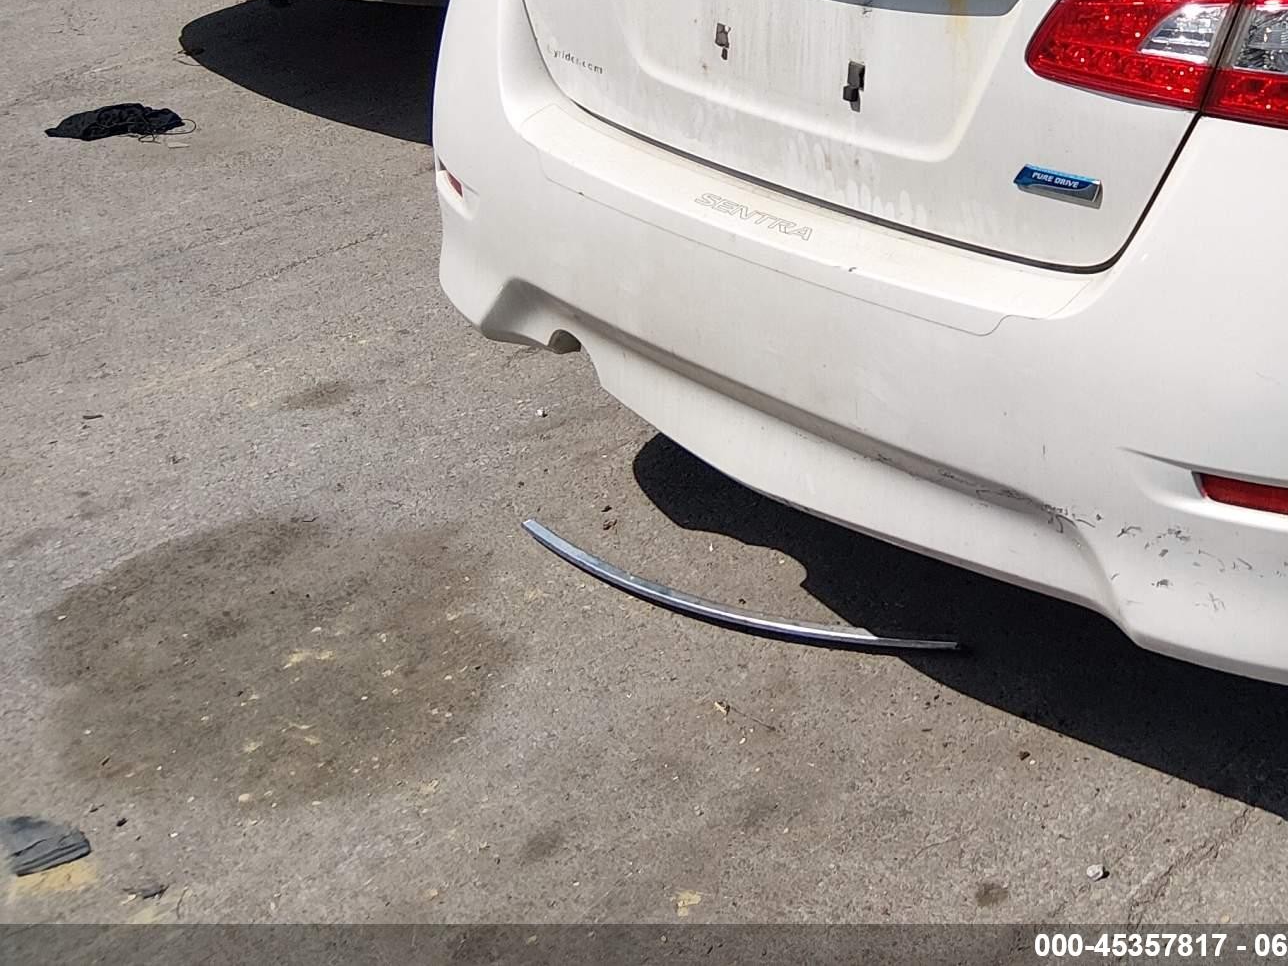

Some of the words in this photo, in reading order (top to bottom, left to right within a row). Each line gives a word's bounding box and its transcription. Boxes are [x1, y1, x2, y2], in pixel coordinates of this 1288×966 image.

[1031, 171, 1054, 183] PURE
[1053, 177, 1080, 189] DRIVE
[694, 192, 813, 241] SENTRA
